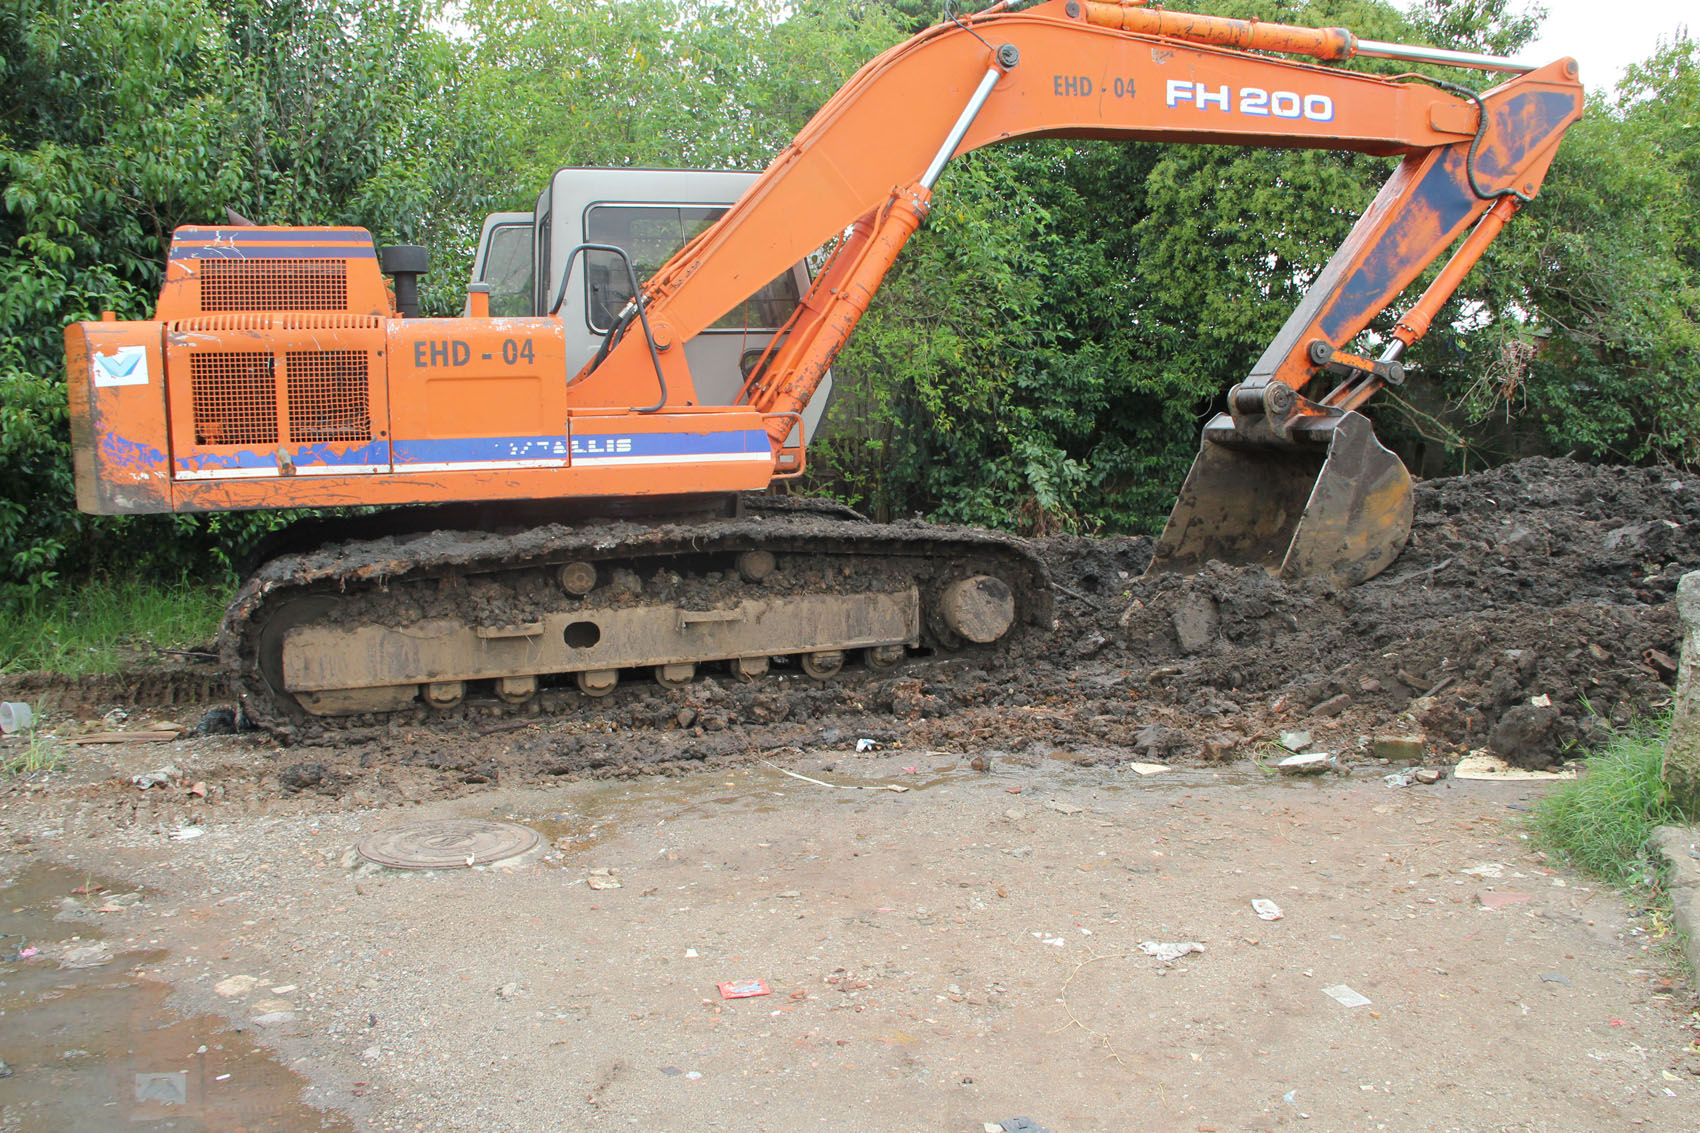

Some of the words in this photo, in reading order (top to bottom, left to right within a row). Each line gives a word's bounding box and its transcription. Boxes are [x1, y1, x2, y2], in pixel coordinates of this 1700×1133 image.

[1053, 75, 1093, 97] EHD
[1113, 77, 1136, 99] 04
[1166, 79, 1231, 113] FH
[1239, 87, 1335, 122] 200
[414, 340, 471, 368] EHD
[502, 338, 535, 365] 04
